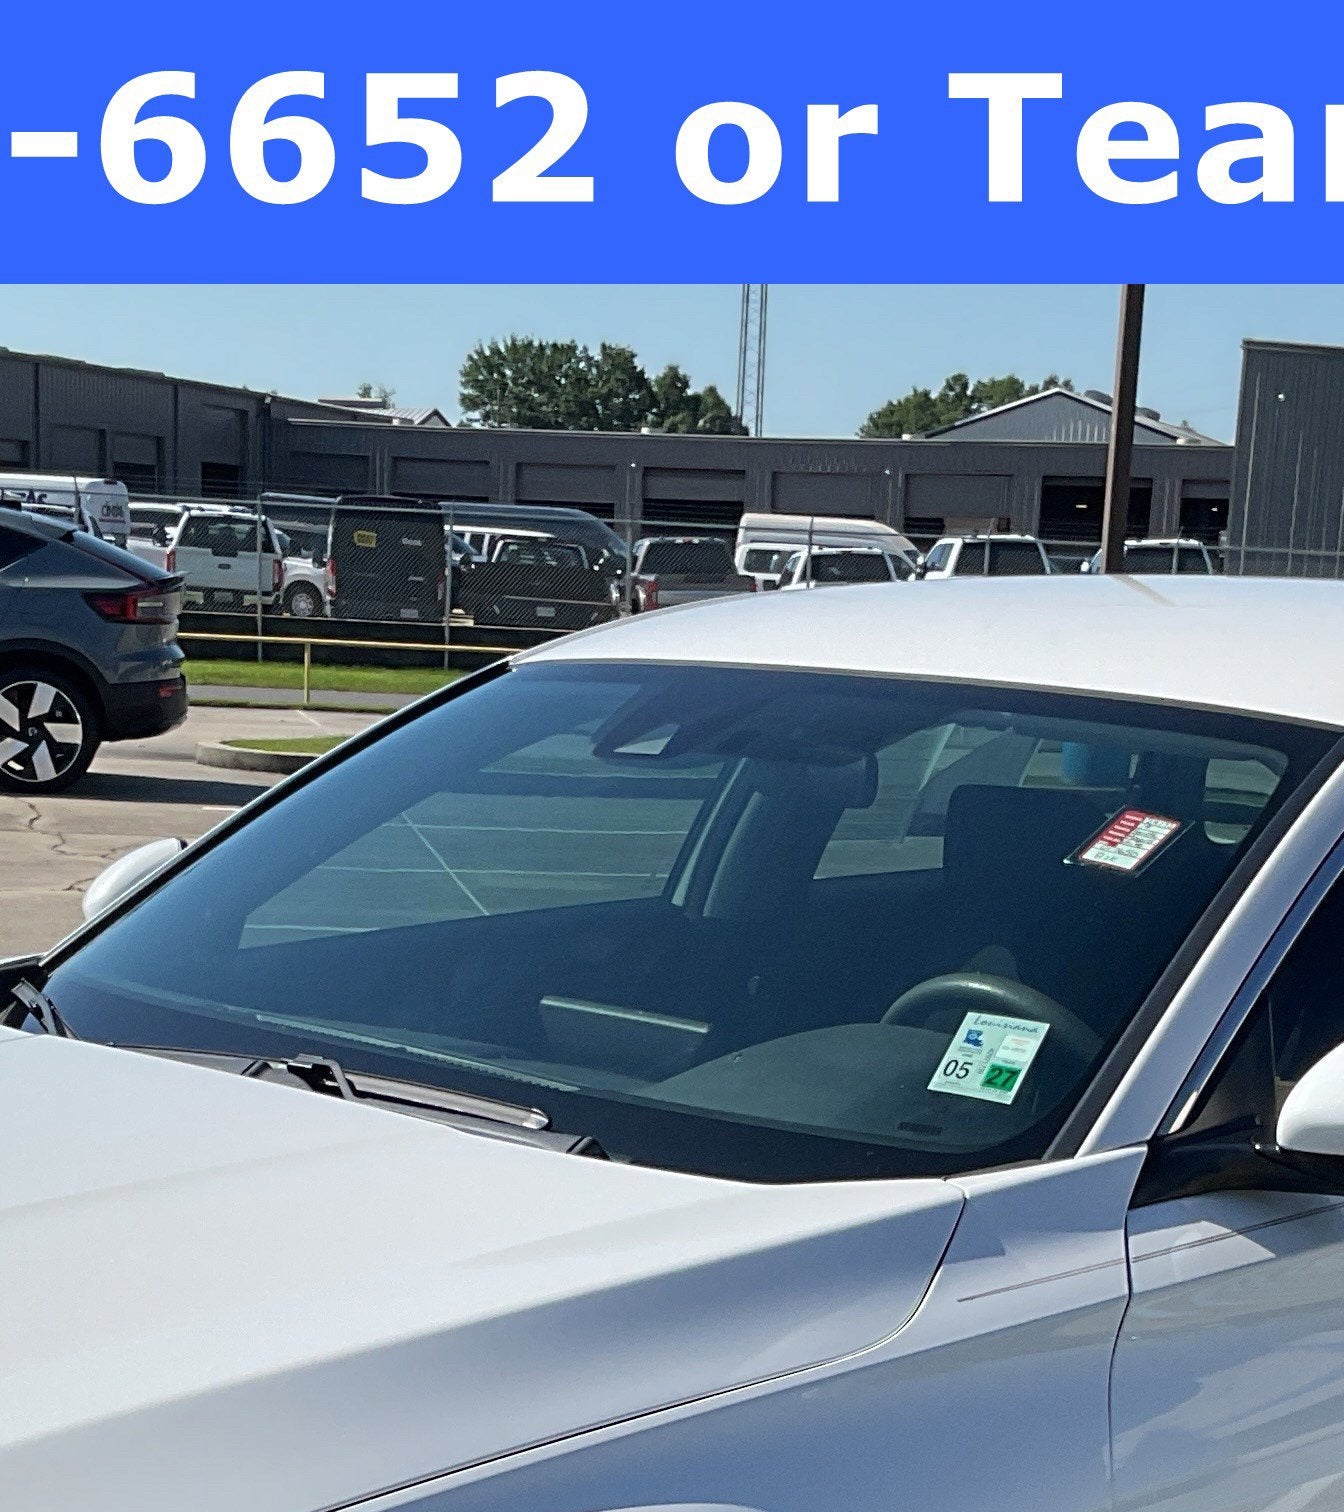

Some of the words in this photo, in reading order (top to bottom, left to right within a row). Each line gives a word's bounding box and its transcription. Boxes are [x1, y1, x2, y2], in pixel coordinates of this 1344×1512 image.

[973, 1015, 1039, 1033] Louisiana
[943, 1059, 973, 1079] 05
[984, 1067, 1019, 1088] 27
